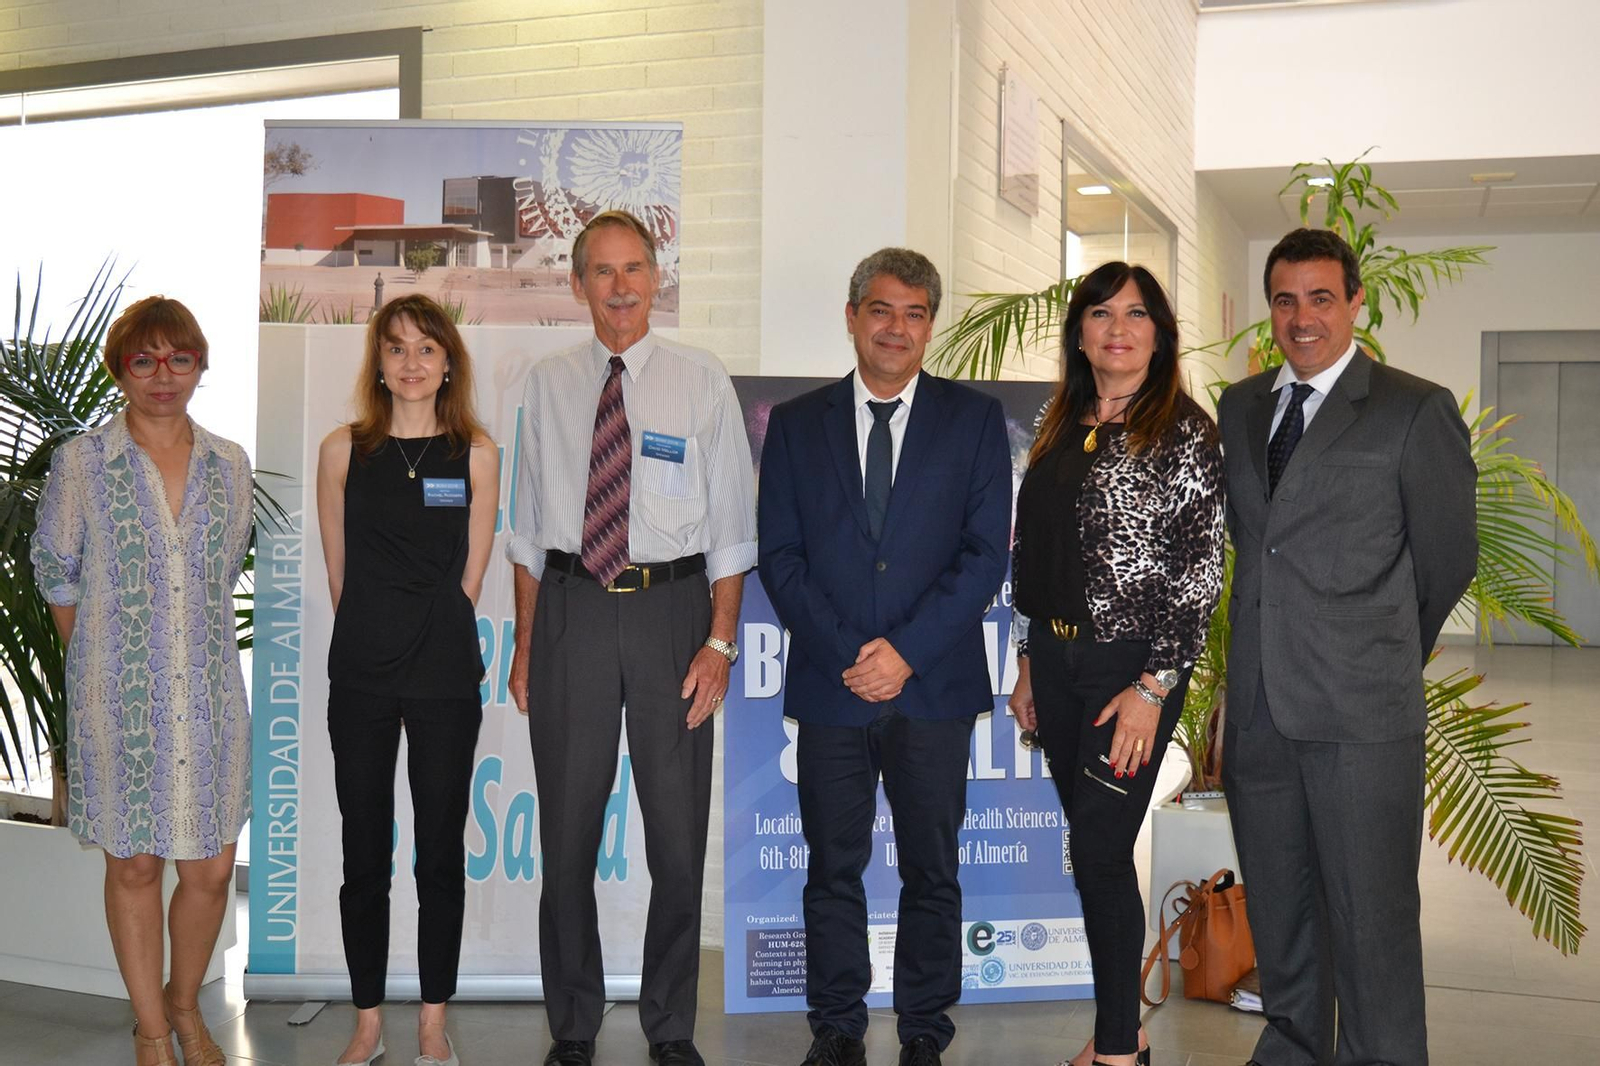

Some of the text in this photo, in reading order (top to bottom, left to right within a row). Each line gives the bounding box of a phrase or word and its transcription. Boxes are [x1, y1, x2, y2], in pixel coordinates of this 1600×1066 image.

[264, 509, 303, 942] UNIVERSIDAD DE ALMERÍA
[466, 754, 632, 882] Sad
[755, 812, 803, 835] Locatio
[963, 807, 1003, 830] Health
[1006, 807, 1058, 829] Sciences
[958, 841, 972, 865] of
[974, 840, 1028, 864] Almería
[746, 911, 897, 924] Organized: ciated
[997, 930, 1013, 943] 25
[1048, 927, 1086, 936] UNIVERSI
[1062, 934, 1088, 943] ALME
[755, 950, 787, 958] Contexts
[752, 960, 782, 968] learning
[783, 959, 791, 967] in
[1008, 961, 1068, 972] UNIVERSIDAD
[1071, 961, 1084, 969] DE
[750, 977, 807, 986] habits. (Univers
[771, 986, 803, 994] Almería)
